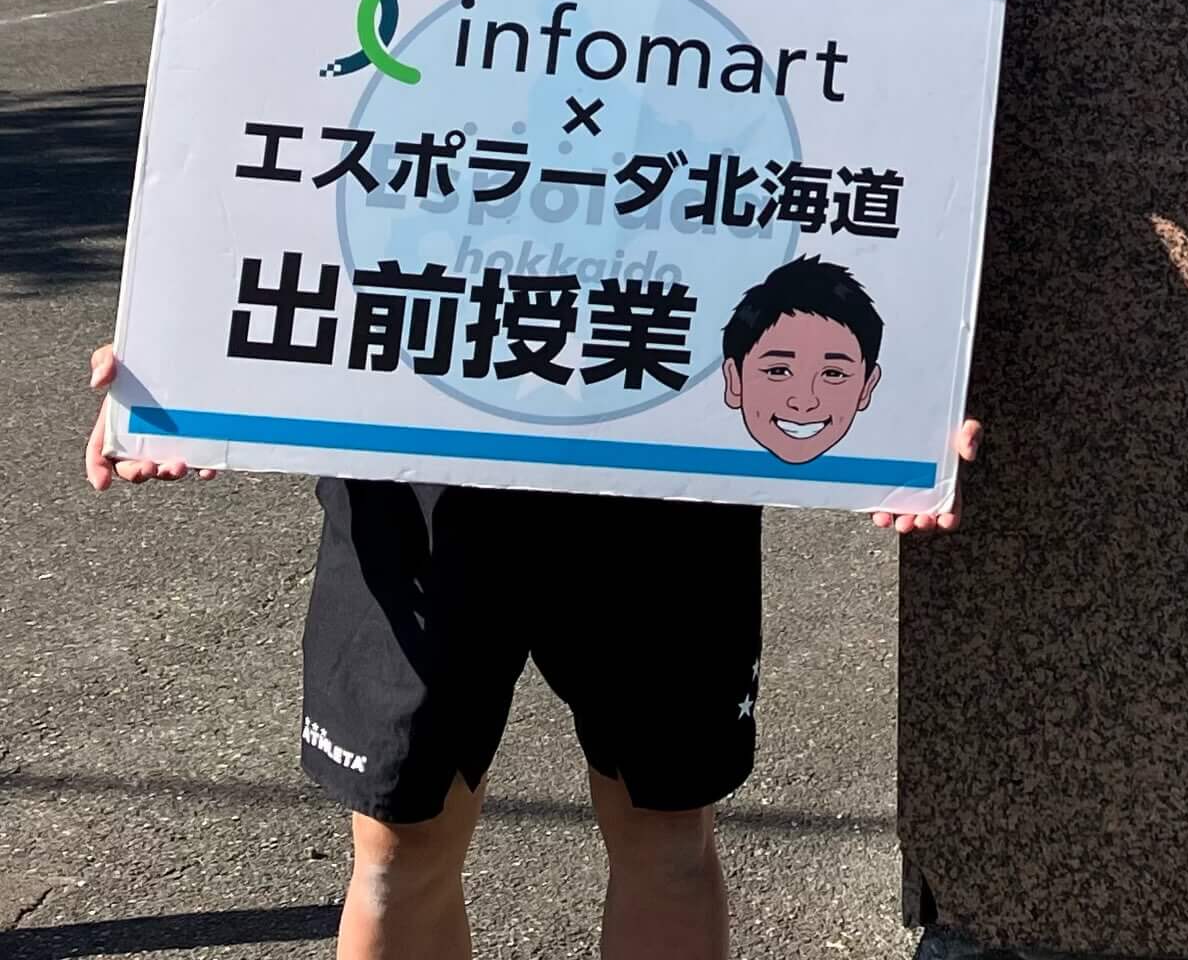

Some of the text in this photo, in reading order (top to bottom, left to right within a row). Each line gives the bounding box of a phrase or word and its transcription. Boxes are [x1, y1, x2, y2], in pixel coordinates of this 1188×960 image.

[234, 121, 905, 239] エスポラーダ北海道
[226, 251, 699, 392] 出前授業
